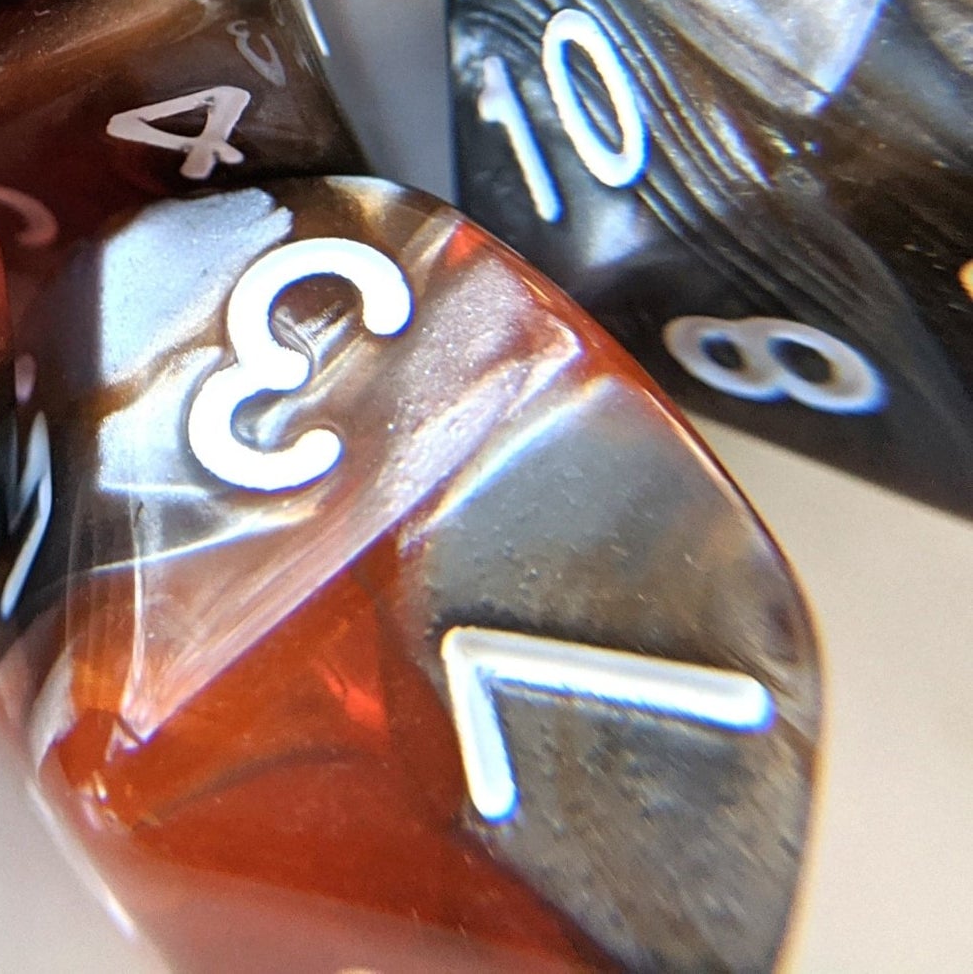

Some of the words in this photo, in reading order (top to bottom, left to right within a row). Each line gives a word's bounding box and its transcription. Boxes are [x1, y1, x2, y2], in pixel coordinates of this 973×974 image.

[106, 85, 252, 180] 4
[477, 7, 649, 223] 10
[187, 236, 413, 492] 3
[661, 314, 889, 415] 8
[441, 626, 777, 825] 7
